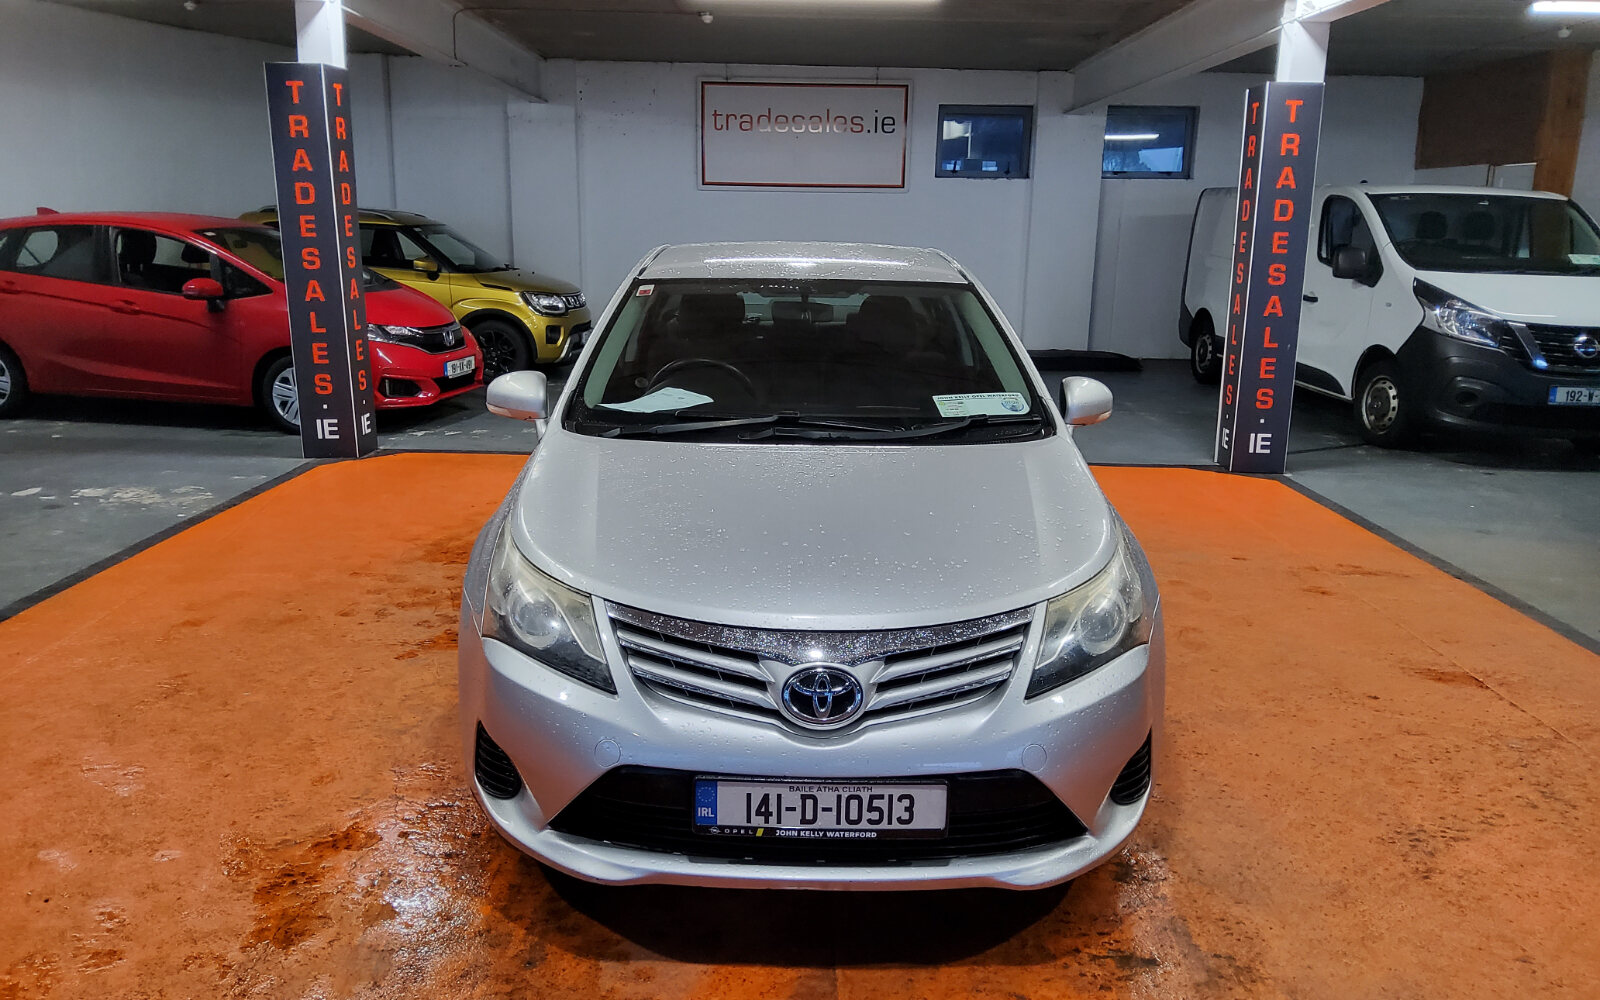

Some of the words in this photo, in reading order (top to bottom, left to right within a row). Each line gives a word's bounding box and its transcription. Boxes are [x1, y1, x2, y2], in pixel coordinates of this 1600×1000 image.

[712, 107, 896, 134] tradesales.ie
[788, 785, 814, 793] BAILE
[842, 785, 873, 793] CLIATH
[697, 807, 715, 817] IRL
[746, 792, 915, 826] 141-D-10513
[775, 829, 799, 837] JOHN
[800, 830, 824, 838] KELLY
[825, 830, 877, 838] WATERFORD
